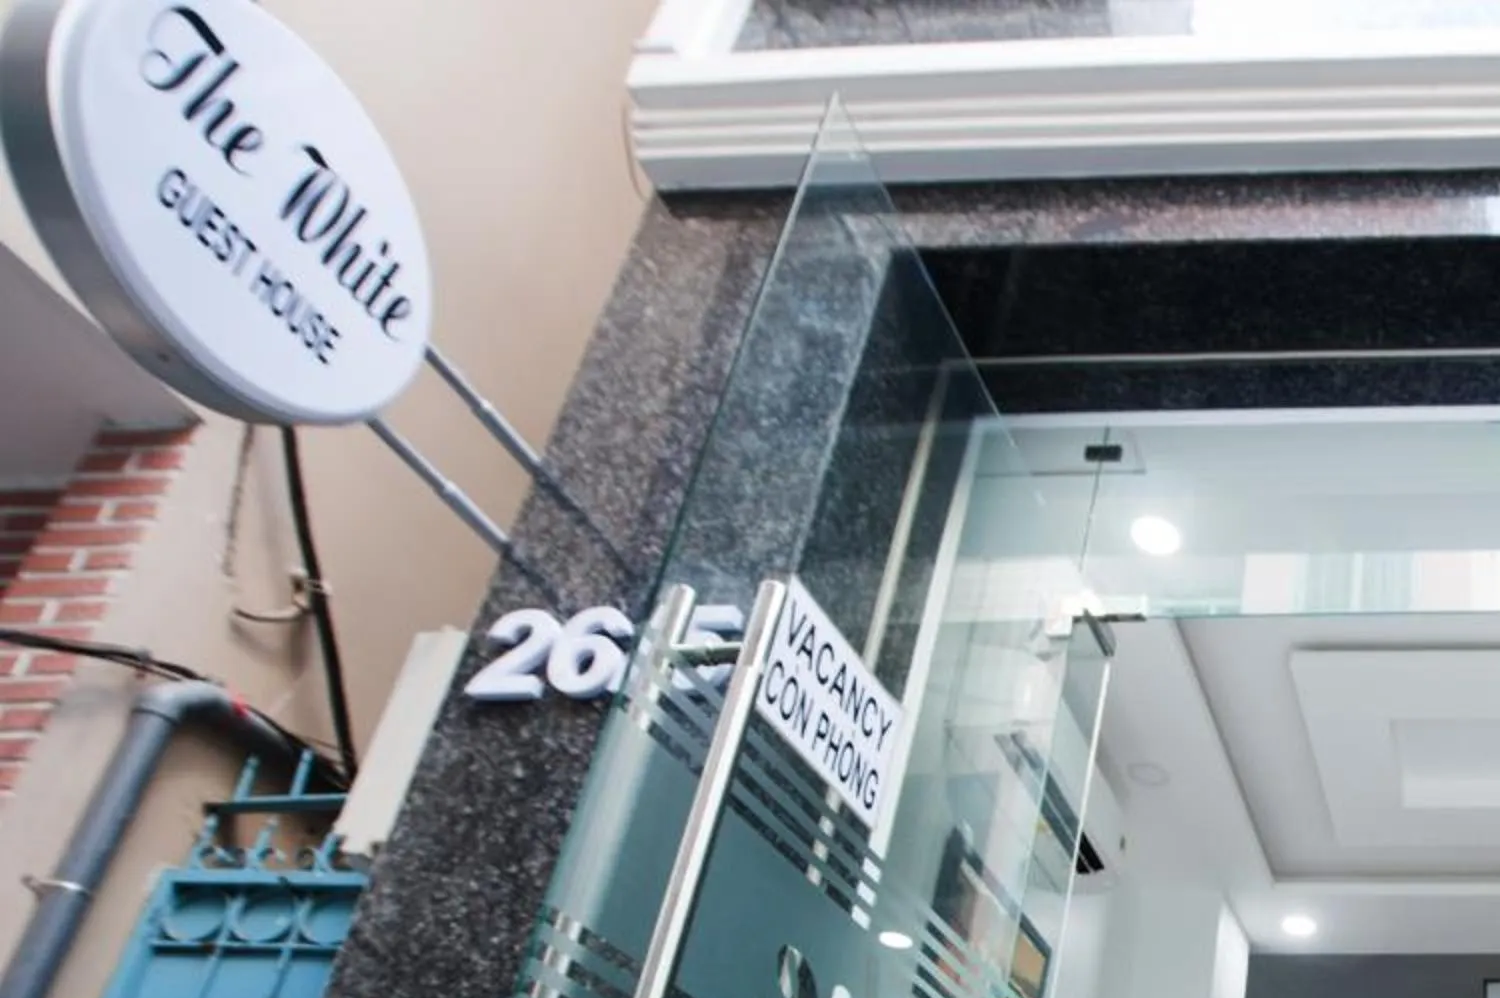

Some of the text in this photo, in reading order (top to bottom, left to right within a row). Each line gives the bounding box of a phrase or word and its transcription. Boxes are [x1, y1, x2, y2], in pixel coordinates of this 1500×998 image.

[138, 5, 413, 341] The White
[156, 167, 344, 365] GUEST HOUSE
[786, 599, 893, 752] VACANCY
